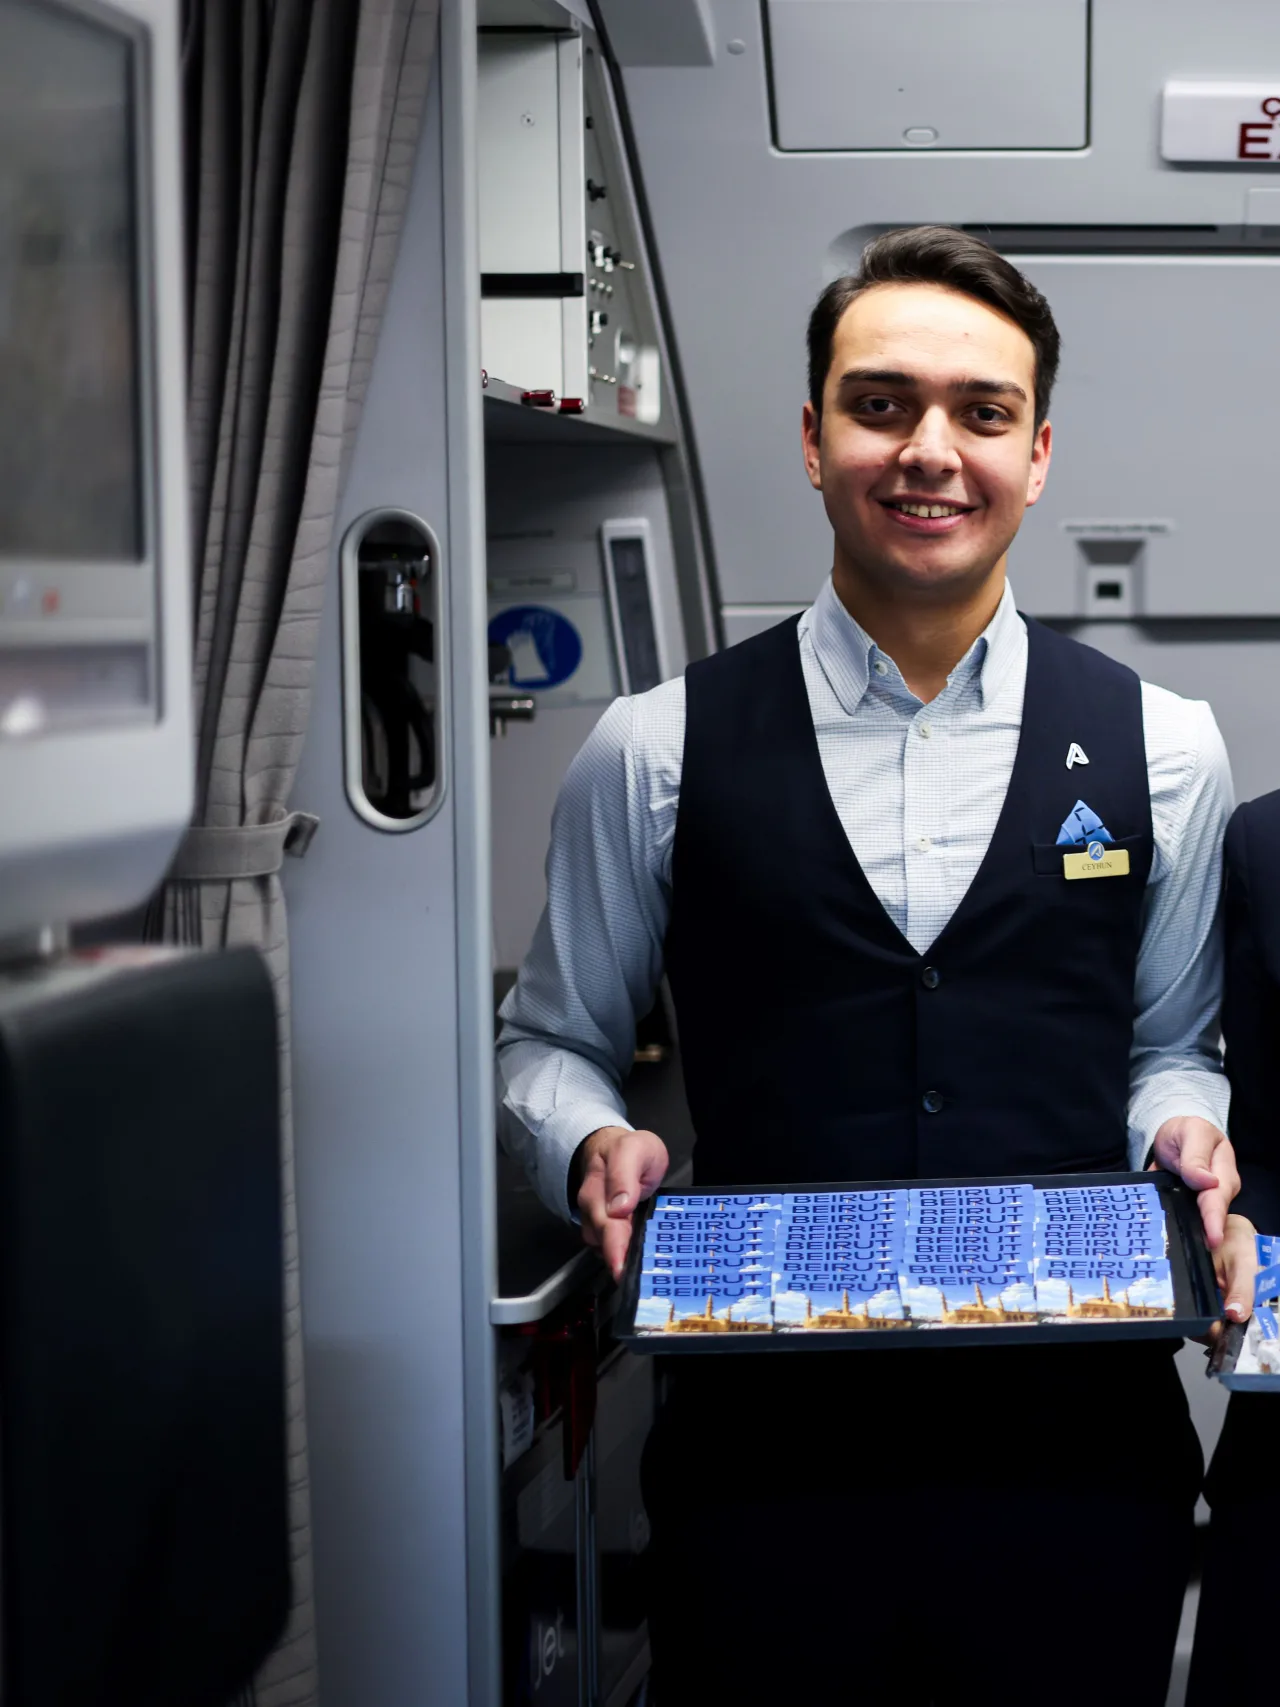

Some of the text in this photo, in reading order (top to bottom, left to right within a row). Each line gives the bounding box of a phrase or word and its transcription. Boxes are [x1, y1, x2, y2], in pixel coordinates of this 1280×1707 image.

[1081, 861, 1112, 871] CEYHUN
[667, 1196, 771, 1206] BEIRUT
[793, 1192, 896, 1203] BEIRUT
[920, 1195, 1023, 1206] BEIRUT
[1045, 1193, 1146, 1205] BEIRUT
[792, 1202, 896, 1213] BEIRUT
[792, 1212, 896, 1223] BEIRUT
[919, 1214, 1024, 1224] BEIRUT
[1049, 1212, 1152, 1222] BEIRUT
[658, 1220, 763, 1231] BEIRUT
[917, 1224, 1022, 1234] BEIRUT
[656, 1232, 763, 1242] BEIRUT
[655, 1243, 762, 1254] BEIRUT
[785, 1239, 892, 1250] BEIRUT
[785, 1250, 893, 1261] BEIRUT
[914, 1252, 1021, 1263] BEIRUT
[1045, 1247, 1151, 1257] BEIRUT
[654, 1257, 762, 1268] BEIRUT
[783, 1261, 891, 1272] BEIRUT
[908, 1264, 1016, 1274] BEIRUT
[1048, 1270, 1155, 1279] BEIRUT
[652, 1273, 761, 1285] BEIRUT
[918, 1275, 1026, 1286] BEIRUT
[652, 1287, 763, 1297] BEIRUT
[787, 1282, 896, 1292] BEIRUT
